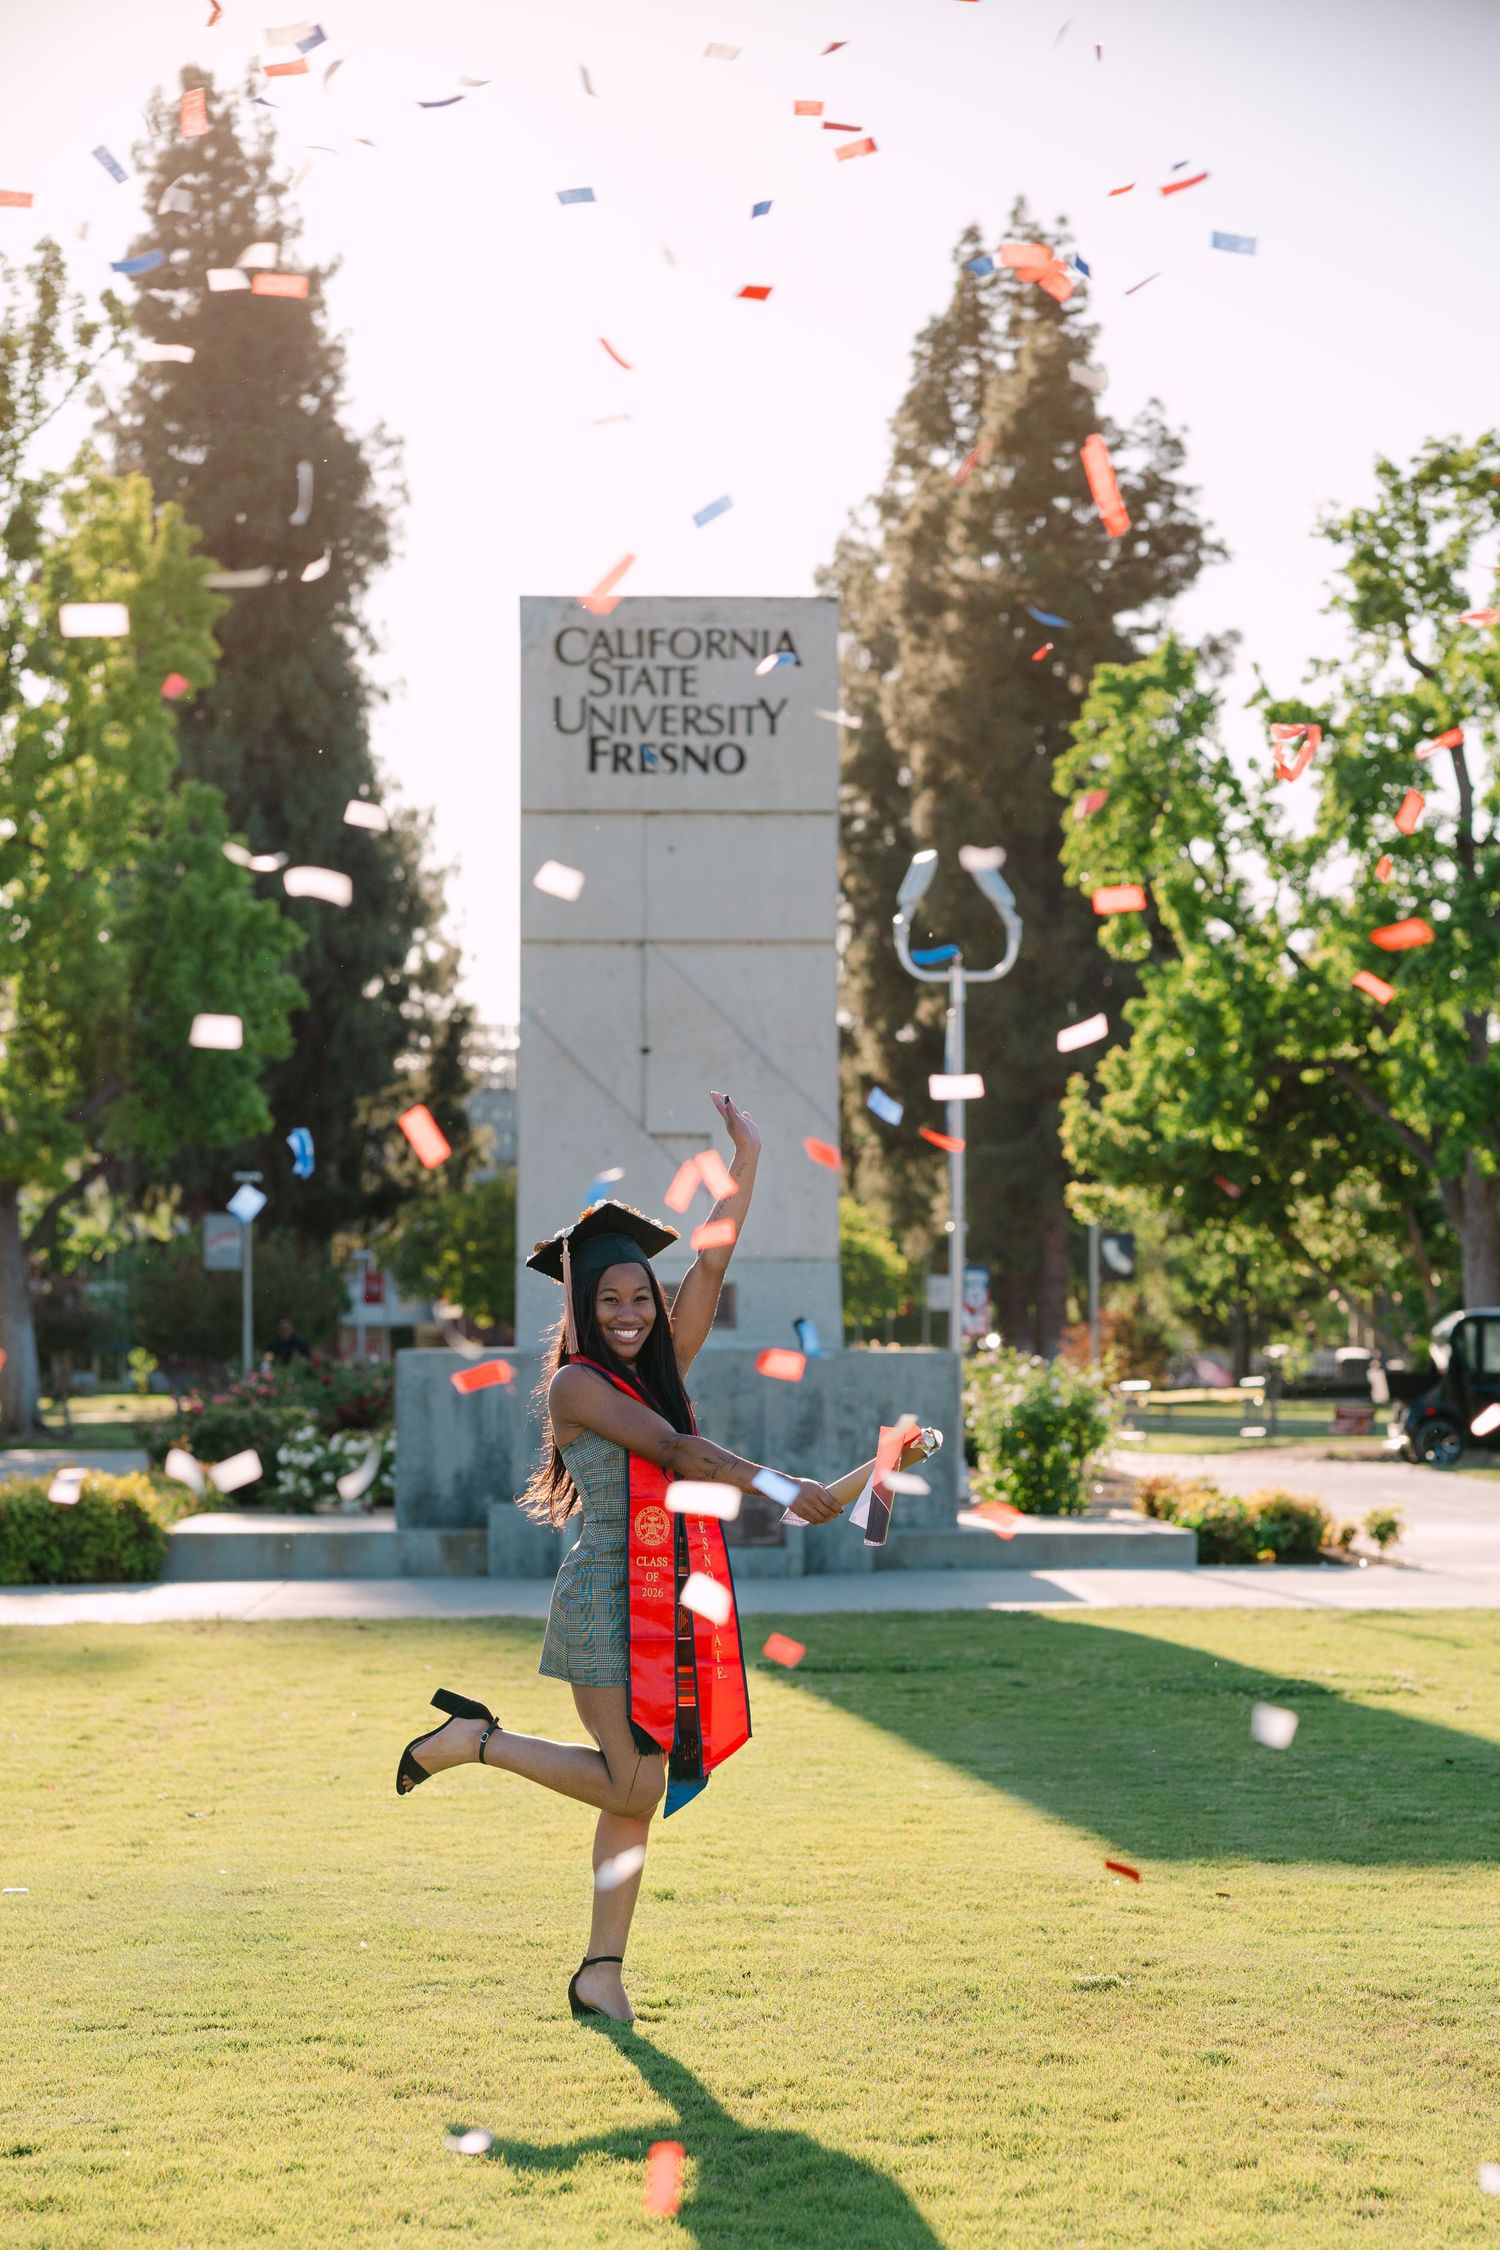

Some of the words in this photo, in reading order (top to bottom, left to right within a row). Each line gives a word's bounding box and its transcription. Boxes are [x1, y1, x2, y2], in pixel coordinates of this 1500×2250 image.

[554, 627, 802, 667] CALIFORNIA
[588, 657, 697, 697] STATE
[553, 696, 788, 736] UNIVERSITY
[587, 736, 747, 775] FRESNO
[636, 1555, 669, 1567] CLASS
[645, 1571, 660, 1583] OF
[641, 1587, 664, 1598] 2026
[714, 1619, 728, 1679] ATE
